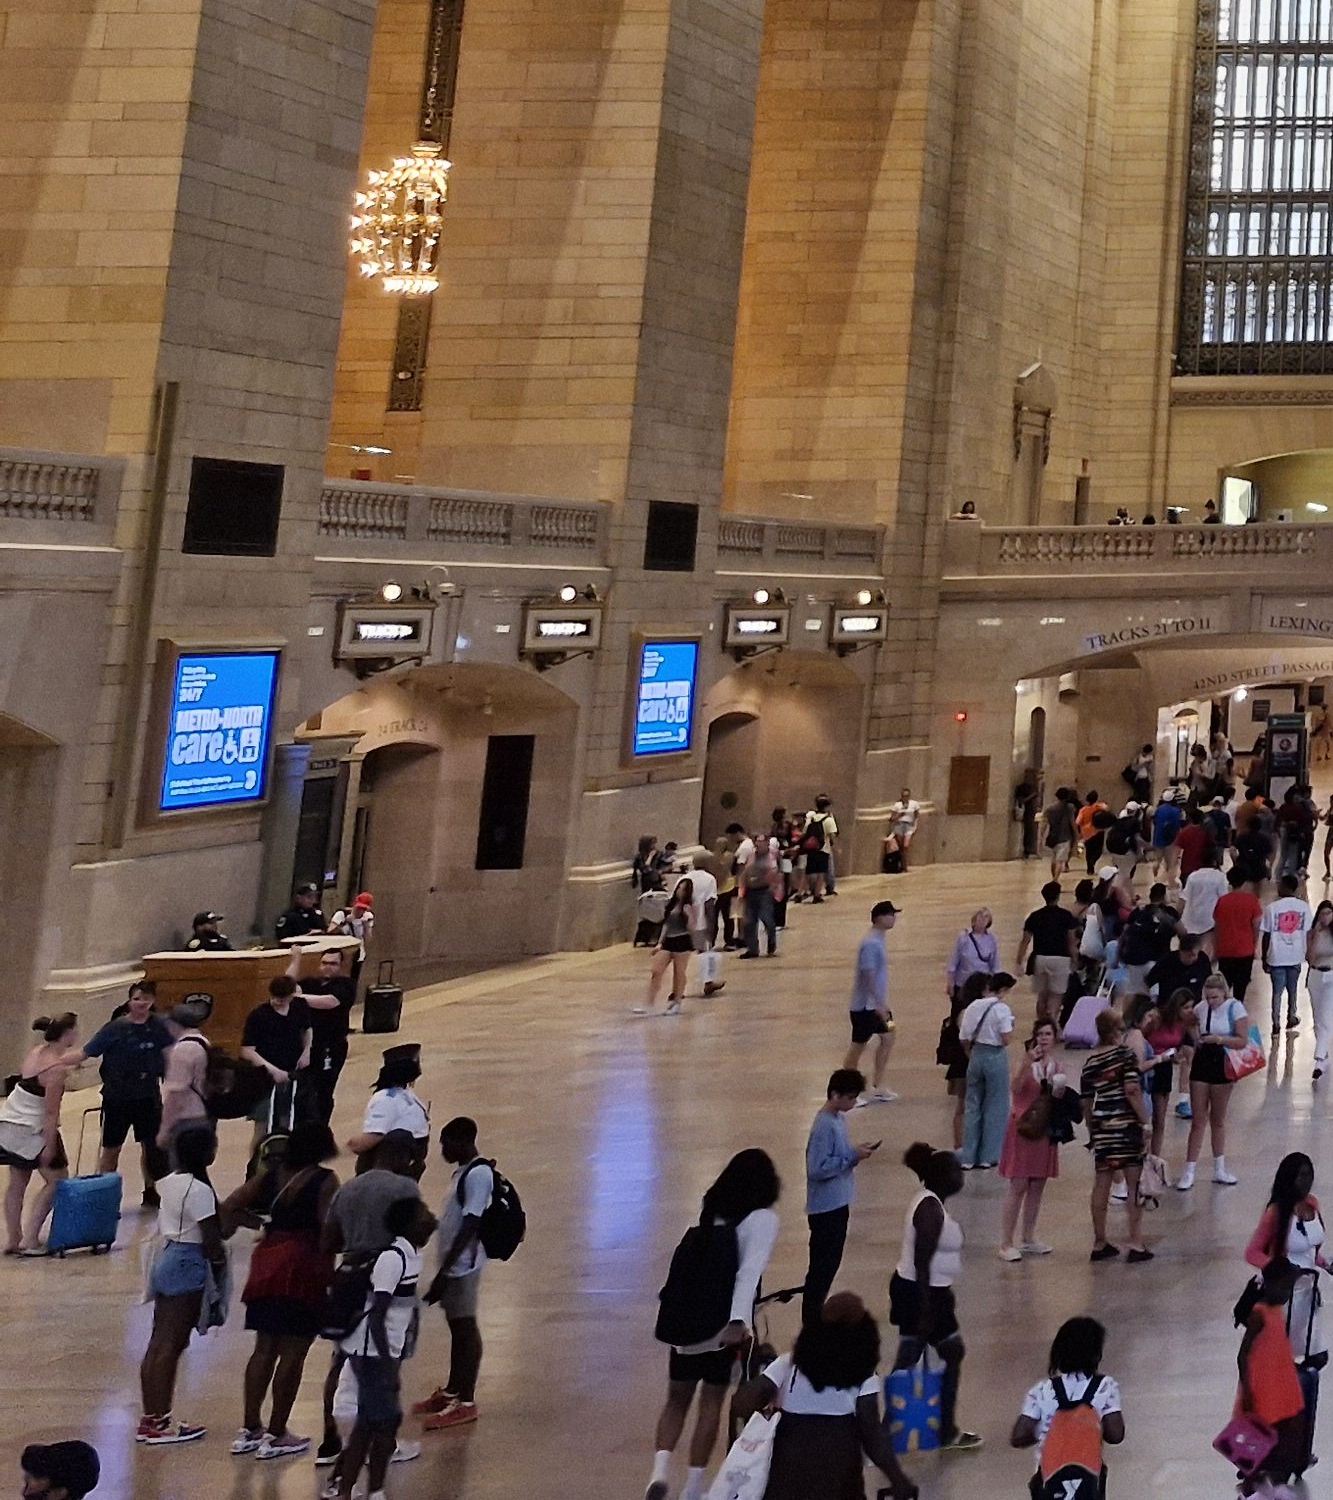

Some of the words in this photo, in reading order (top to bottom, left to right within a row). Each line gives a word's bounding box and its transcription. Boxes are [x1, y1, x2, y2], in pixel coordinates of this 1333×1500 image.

[1086, 628, 1151, 650] TRACKS
[1154, 623, 1169, 637] 21
[1175, 619, 1195, 633] TO
[1199, 618, 1211, 631] 11
[1194, 674, 1228, 690] 42ND
[1231, 665, 1280, 681] STREET
[175, 705, 264, 733] METRO-NORTH
[171, 730, 224, 765] care
